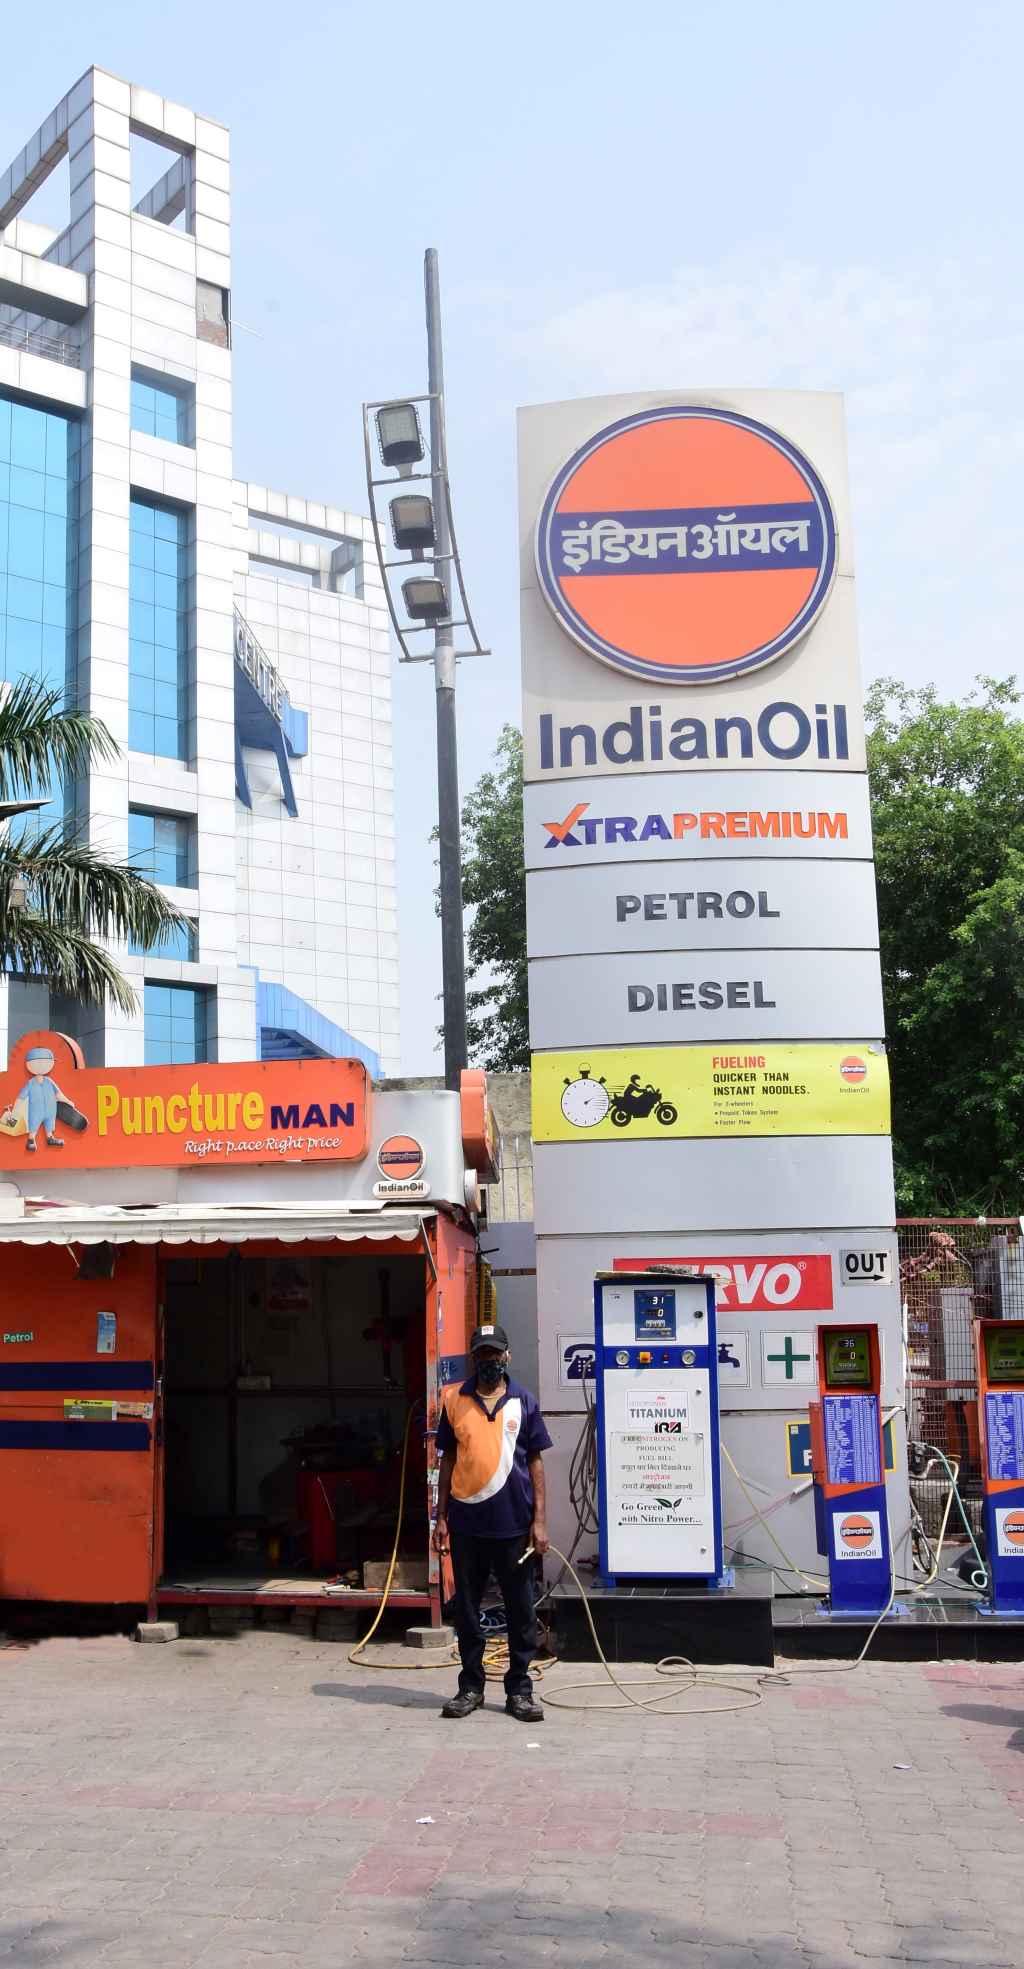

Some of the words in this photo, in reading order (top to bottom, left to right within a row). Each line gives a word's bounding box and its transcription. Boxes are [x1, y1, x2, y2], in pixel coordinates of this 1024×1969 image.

[561, 512, 811, 573] इंडियनऑयल
[539, 701, 850, 770] IndianOil
[616, 890, 781, 922] PETROL
[628, 981, 777, 1013] DIESEL
[712, 1056, 766, 1069] FUELING
[713, 1073, 757, 1083] QUICKER
[763, 1072, 790, 1082] THAN
[713, 1086, 756, 1096] INSTANT
[96, 1082, 264, 1136] Puncture
[270, 1102, 355, 1129] MAN
[184, 1139, 222, 1157] Right
[265, 1136, 304, 1153] Right
[307, 1137, 341, 1152] price
[378, 1183, 424, 1192] IndianOil
[845, 1253, 887, 1273] OUT
[690, 1263, 802, 1304] RVO
[3, 1332, 34, 1343] Petrol
[630, 1408, 687, 1418] TITANIUM
[621, 1503, 634, 1511] Go
[636, 1503, 663, 1511] Green
[640, 1515, 664, 1523] Nitro
[841, 1549, 877, 1558] IndianOil
